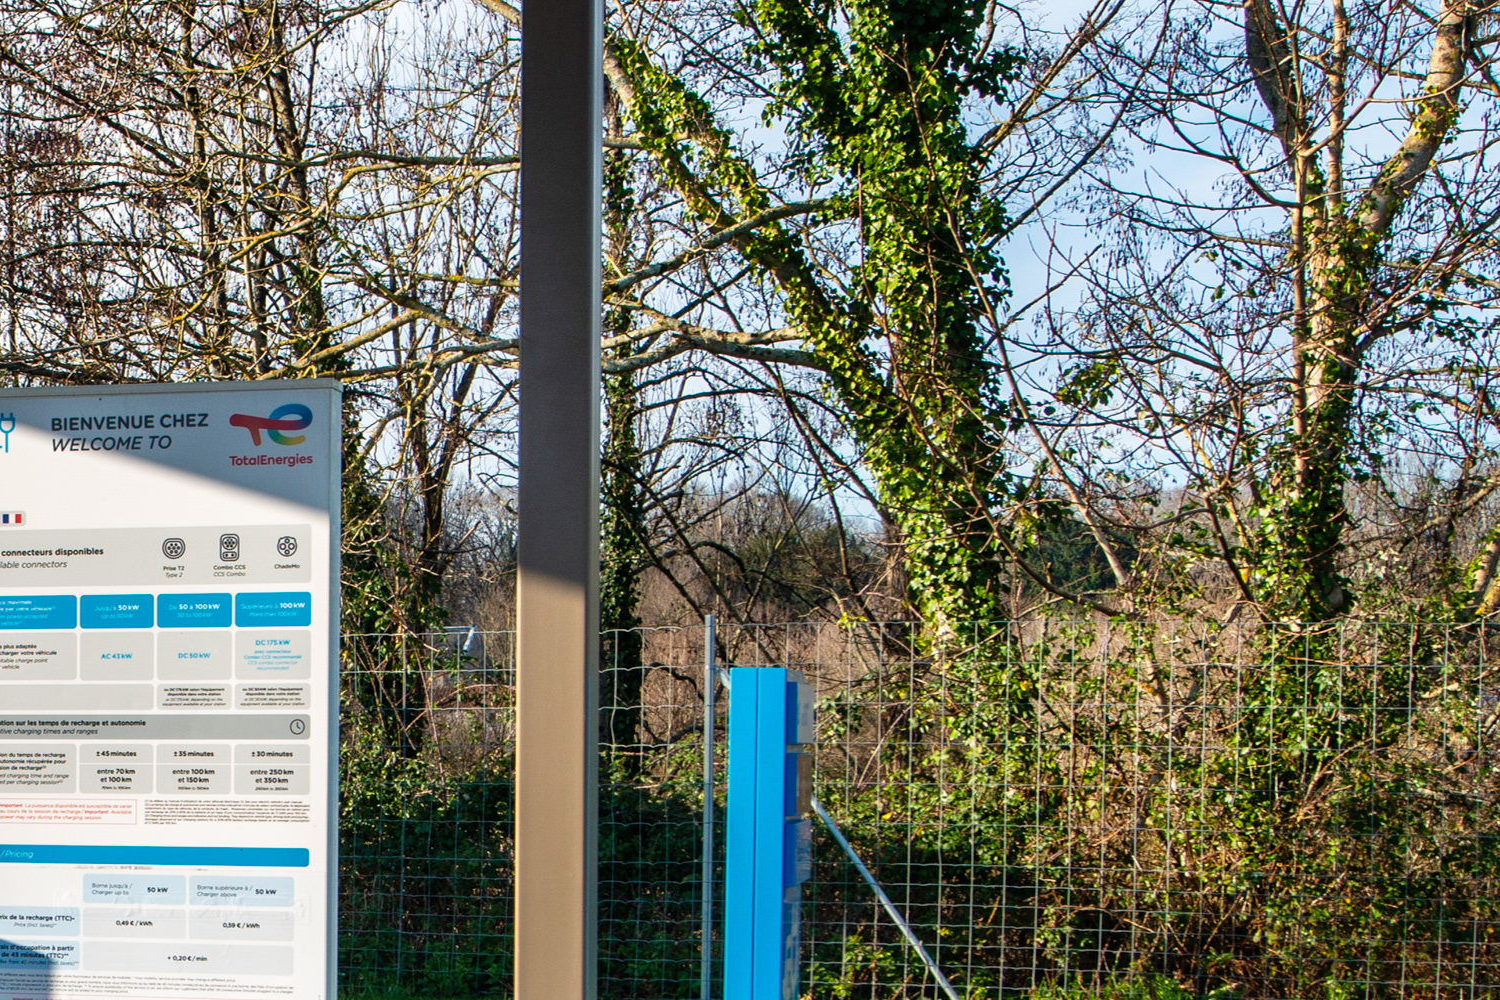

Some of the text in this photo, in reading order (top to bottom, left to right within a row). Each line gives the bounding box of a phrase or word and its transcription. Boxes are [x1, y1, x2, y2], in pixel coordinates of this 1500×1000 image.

[51, 413, 209, 432] BIENVENUE CHEZ
[52, 435, 172, 452] WELCOME TO
[229, 454, 313, 467] TotalEnergies
[1, 549, 53, 557] connecteurs
[55, 547, 104, 557] disponibles
[21, 560, 67, 568] connectors
[71, 719, 100, 728] recharge
[13, 728, 42, 736] charging
[5, 850, 34, 859] Pricing
